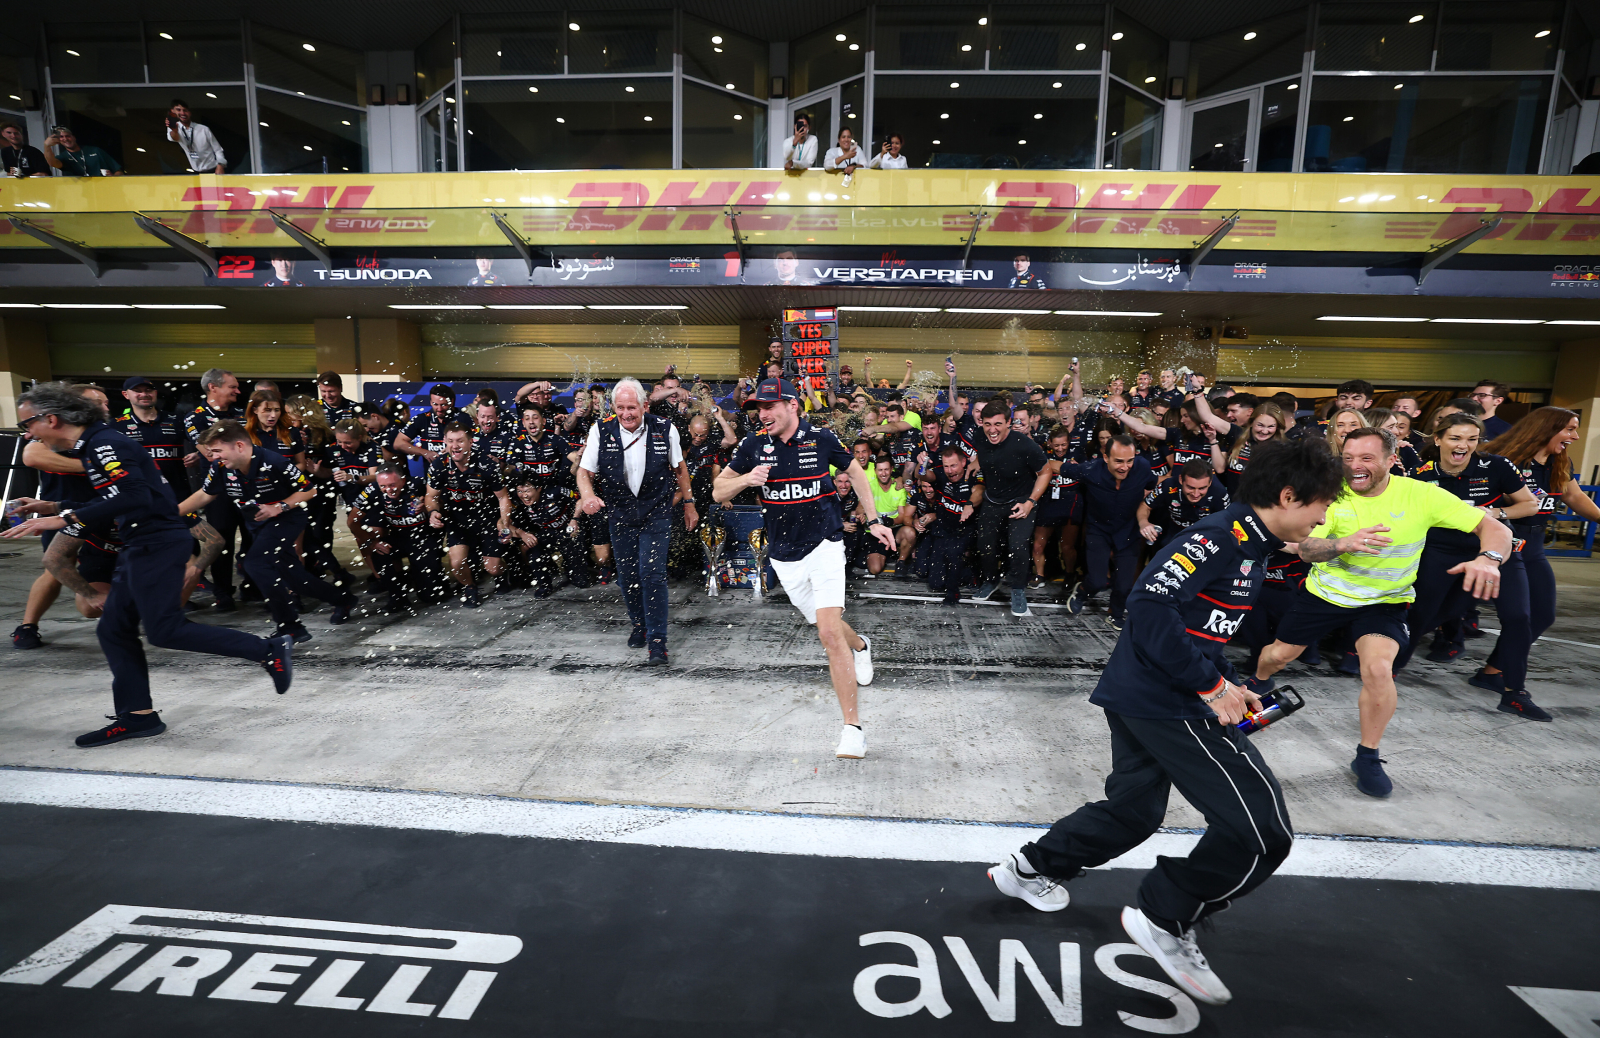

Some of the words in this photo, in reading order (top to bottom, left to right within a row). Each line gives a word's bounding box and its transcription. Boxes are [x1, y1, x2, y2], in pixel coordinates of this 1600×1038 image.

[180, 185, 381, 234] DHL
[564, 181, 790, 231] DHL
[986, 181, 1226, 236] DHL
[1430, 187, 1600, 241] DH
[217, 255, 255, 279] 22
[313, 268, 433, 280] TSUNODA
[723, 251, 741, 277] 1
[813, 267, 994, 281] VERSTAPPEN
[797, 323, 822, 339] YES
[791, 340, 831, 357] SUPER
[1229, 459, 1244, 471] Re
[761, 483, 790, 500] Red
[791, 480, 821, 499] Bull
[1190, 533, 1220, 555] Mobil
[1202, 608, 1246, 636] Red
[0, 904, 523, 1020] PIRELLI
[853, 930, 1200, 1035] aws
